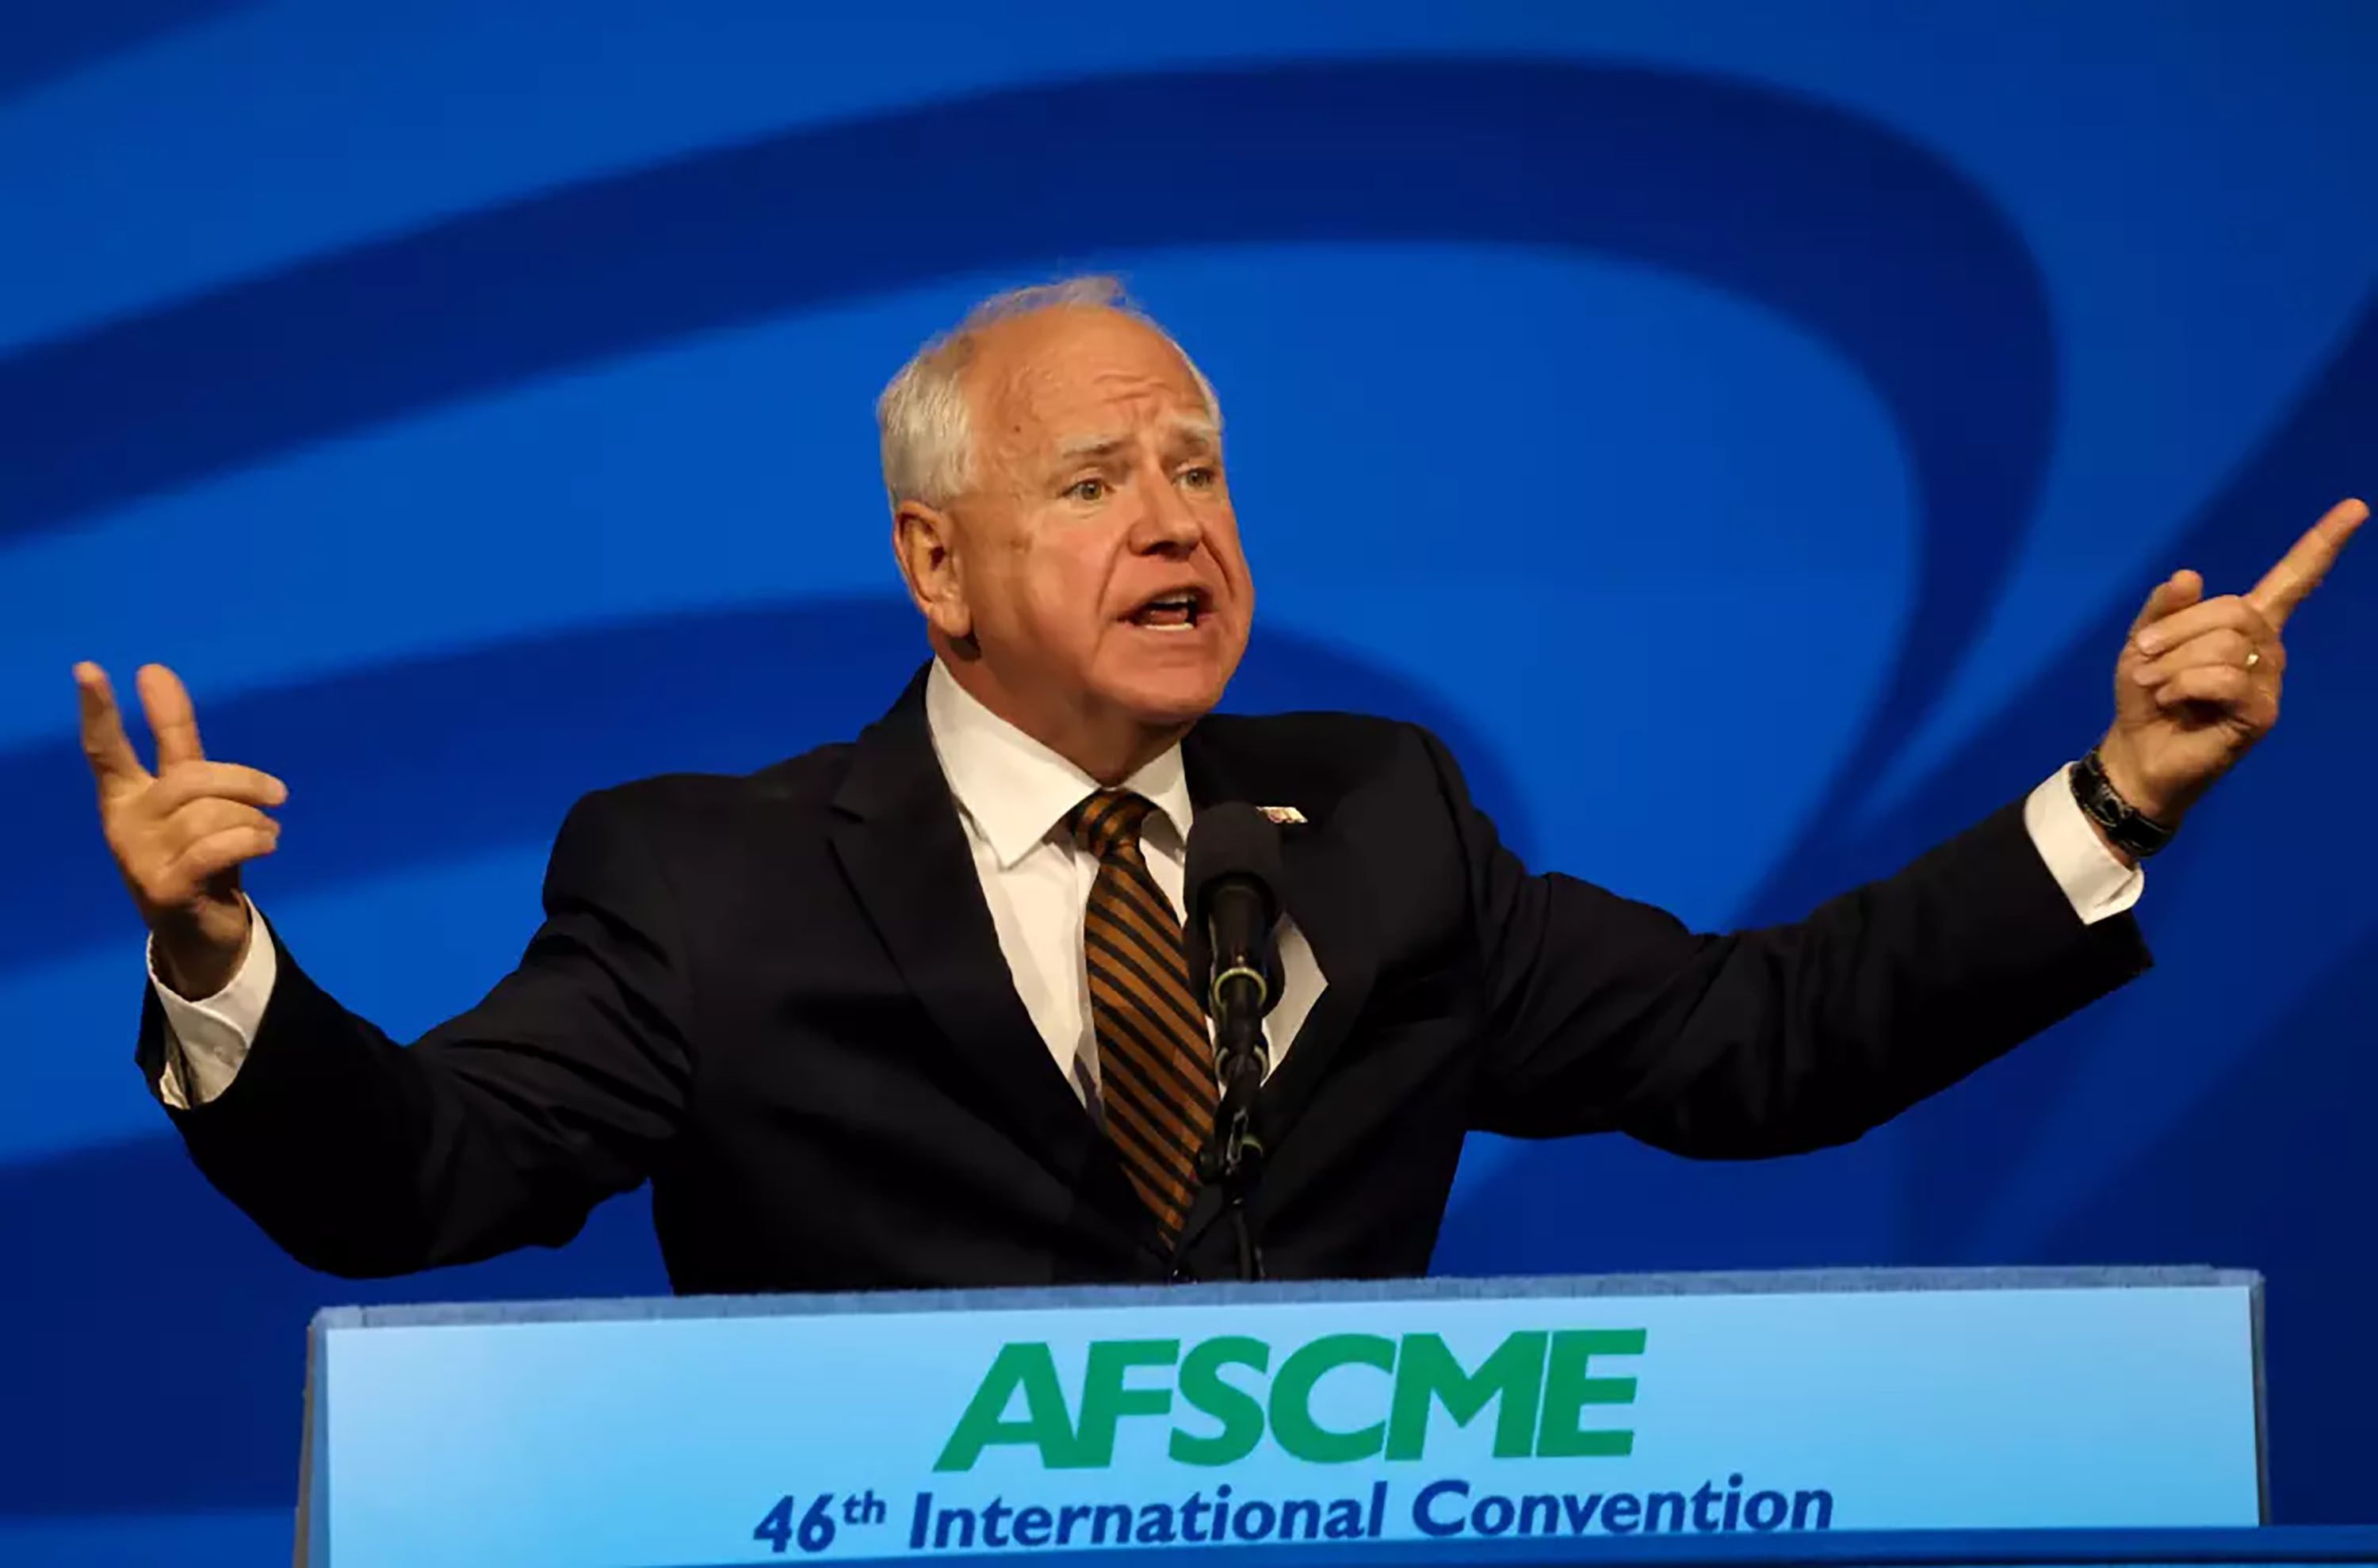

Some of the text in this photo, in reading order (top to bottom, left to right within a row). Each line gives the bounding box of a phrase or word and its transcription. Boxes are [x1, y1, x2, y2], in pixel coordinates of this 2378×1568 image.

[933, 1329, 1646, 1472] AFSCME
[752, 1472, 1834, 1554] 46th International Convention
